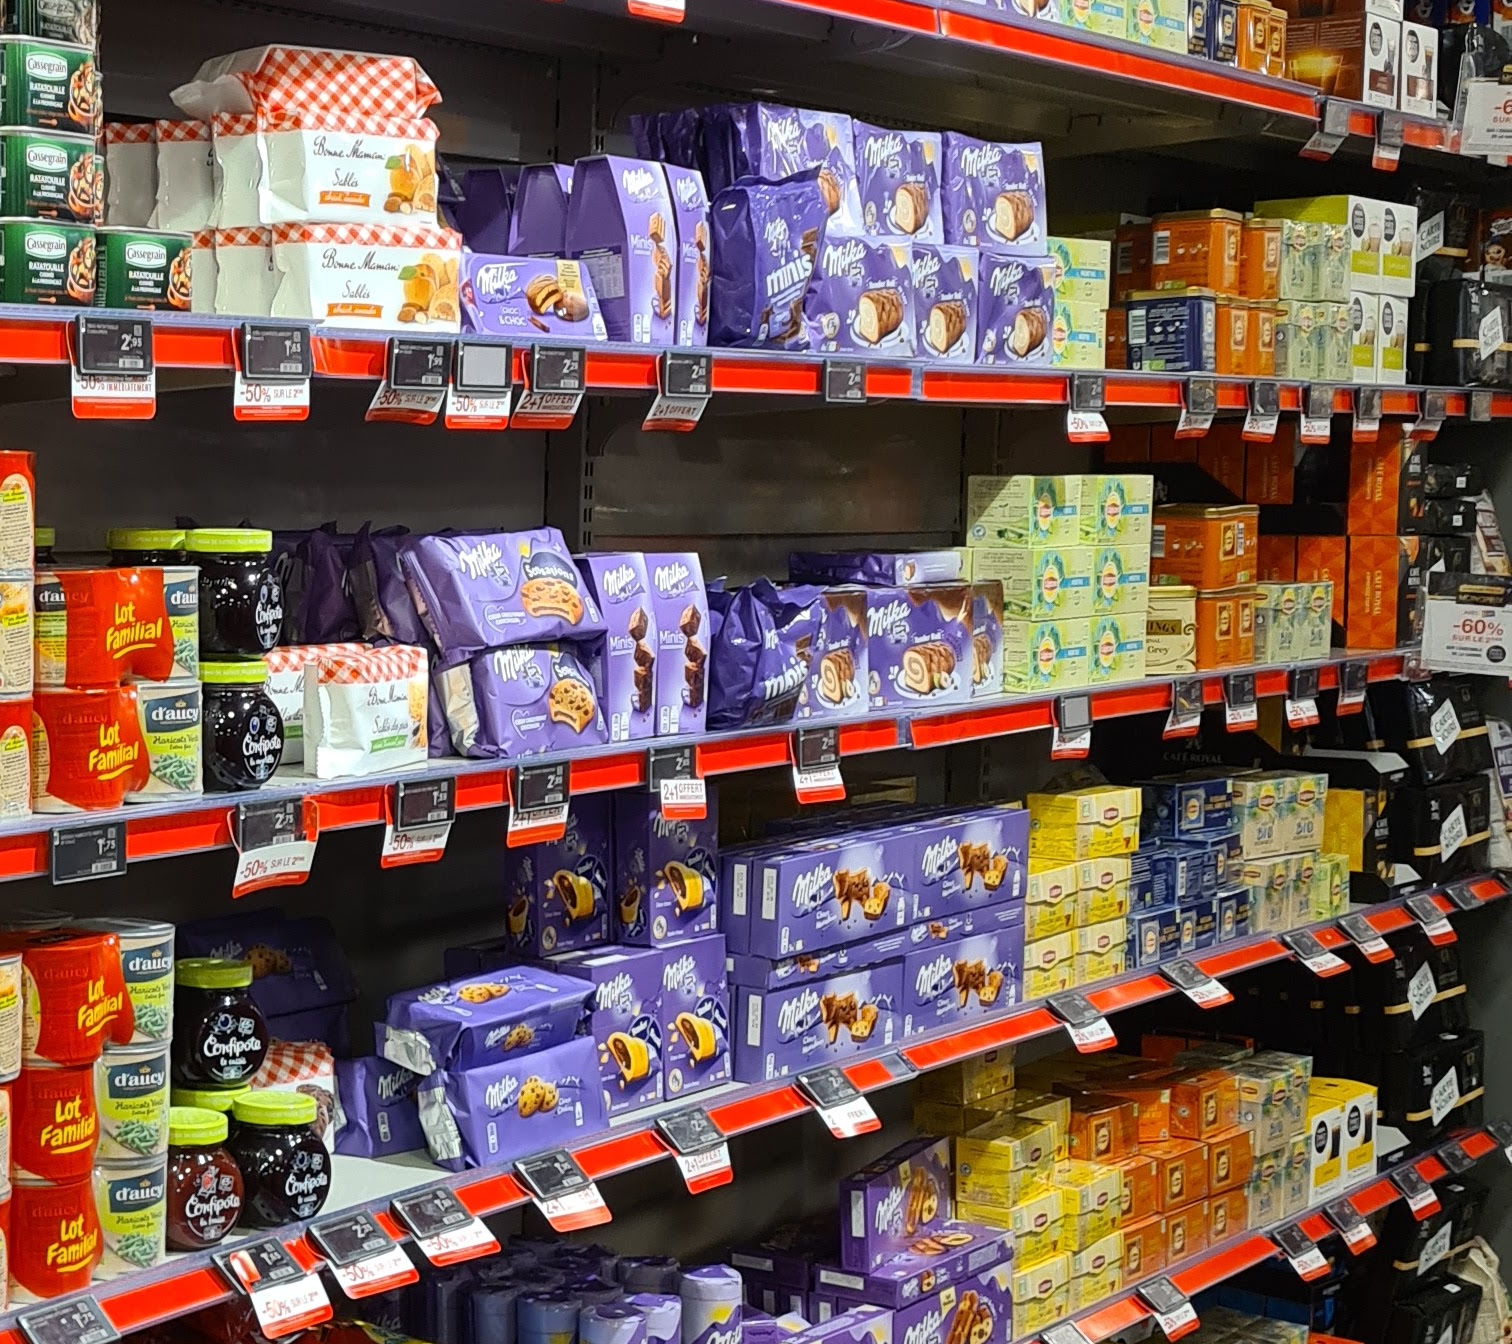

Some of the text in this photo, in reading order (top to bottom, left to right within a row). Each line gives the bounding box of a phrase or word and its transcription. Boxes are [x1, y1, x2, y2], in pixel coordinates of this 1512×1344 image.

[27, 54, 67, 76] Cassegrain
[962, 143, 1002, 176] Milka
[322, 247, 356, 270] Bonne
[766, 255, 813, 299] minis
[1453, 618, 1504, 636] -60%
[99, 722, 121, 748] Lot
[792, 864, 835, 907] Milka
[203, 1034, 262, 1058] Confipote
[114, 1070, 165, 1088] d'aucy
[485, 1076, 520, 1112] Milka
